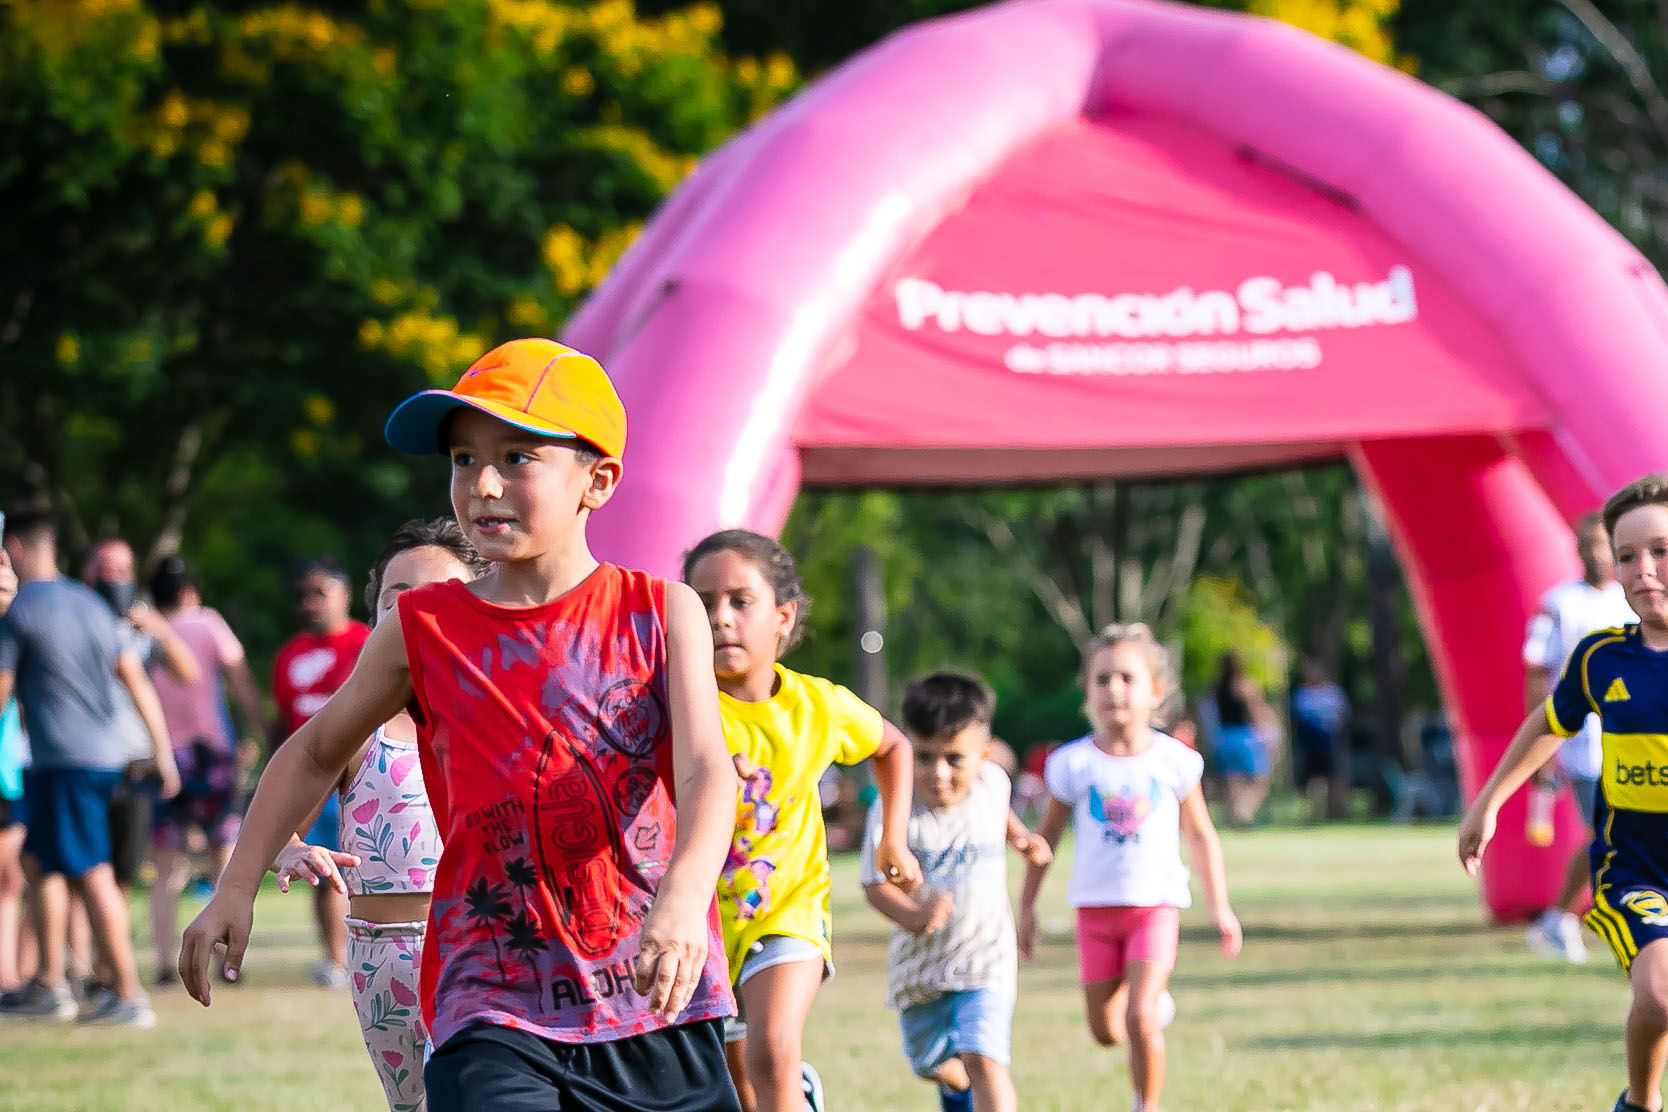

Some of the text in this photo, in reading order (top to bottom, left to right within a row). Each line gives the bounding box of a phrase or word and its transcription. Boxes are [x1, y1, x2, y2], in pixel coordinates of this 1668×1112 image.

[1239, 268, 1414, 333] Salud
[480, 798, 524, 820] WITH
[482, 818, 512, 837] THE
[483, 831, 524, 856] FLOW
[551, 956, 640, 1010] ALOH
